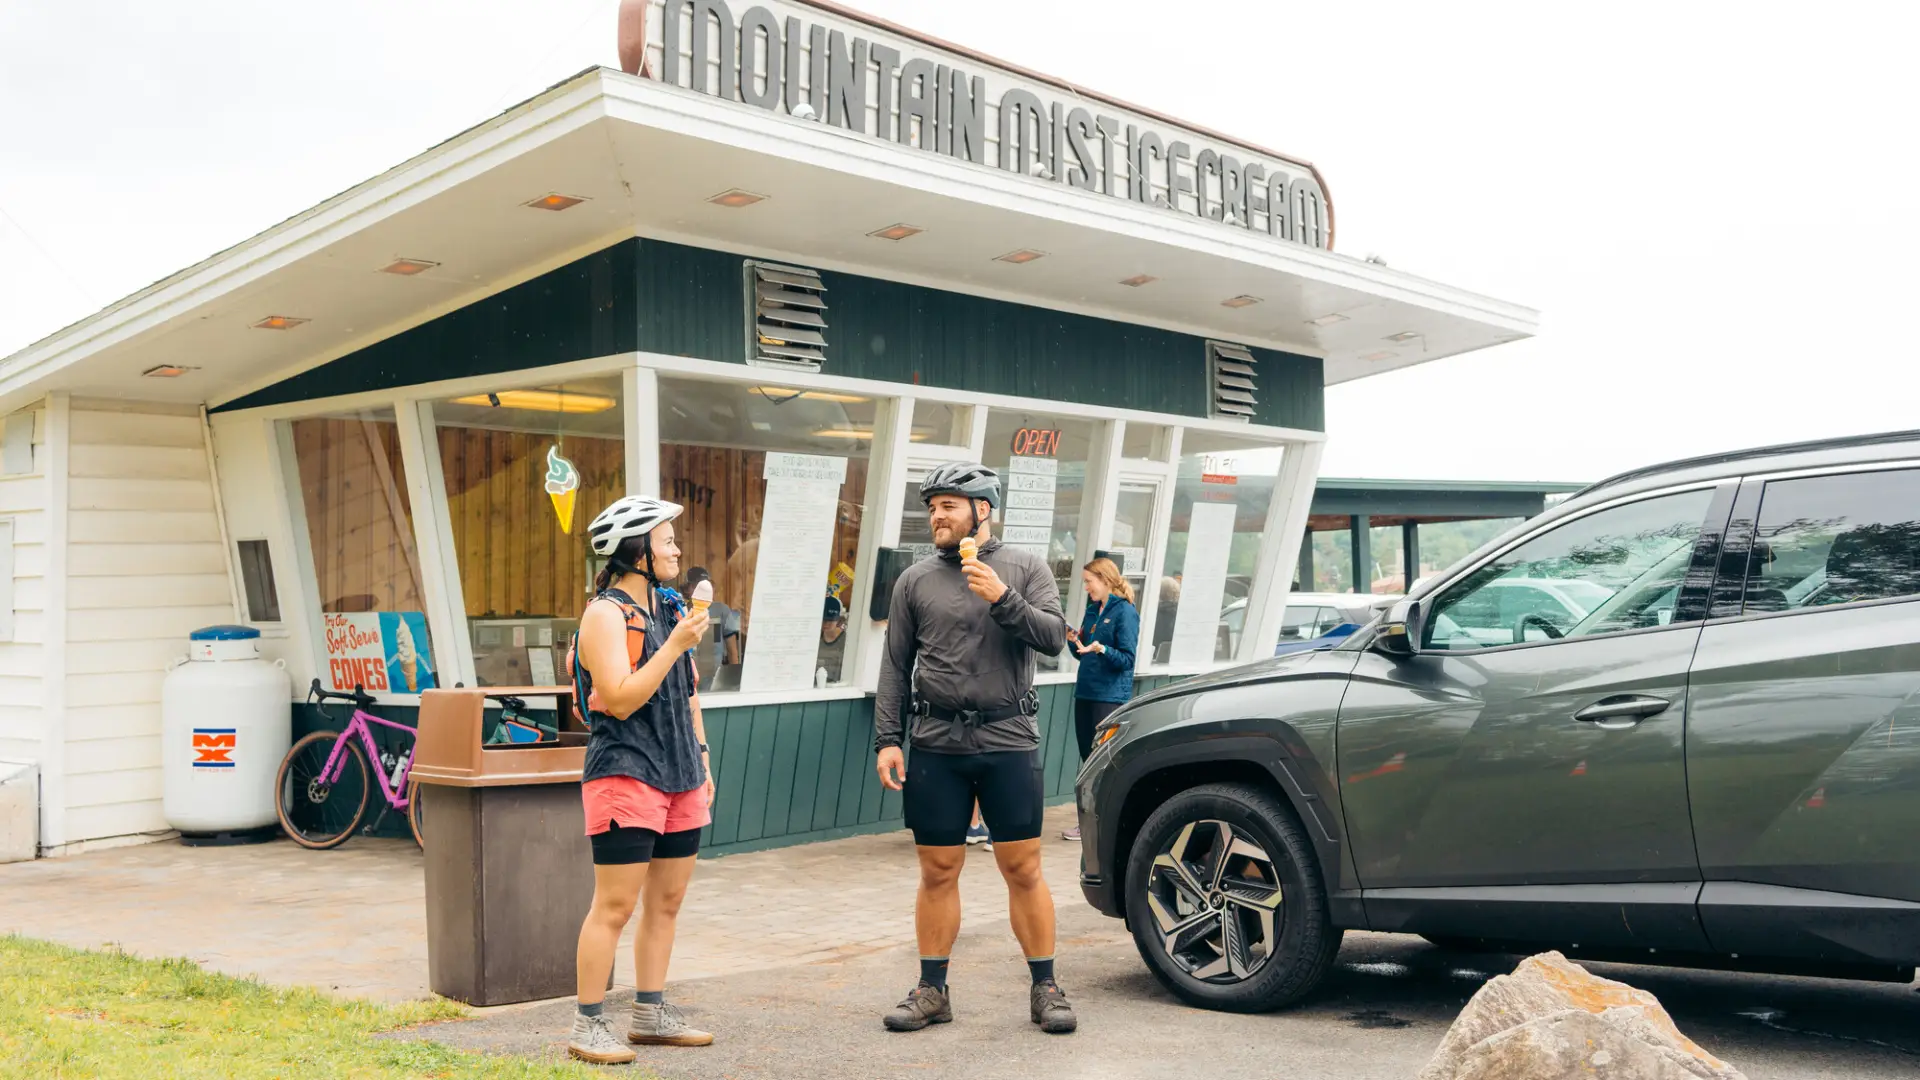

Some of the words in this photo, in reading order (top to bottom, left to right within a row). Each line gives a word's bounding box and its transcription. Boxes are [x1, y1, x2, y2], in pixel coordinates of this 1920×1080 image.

[664, 0, 985, 165] MOUNTAIN
[999, 87, 1120, 197] MIST
[1126, 124, 1192, 213] ICE
[1196, 148, 1326, 249] CREAM
[1013, 428, 1062, 456] OPEN
[324, 614, 335, 629] Try
[335, 613, 349, 628] Our
[326, 627, 349, 656] Soft
[348, 624, 380, 650] Serve
[329, 657, 388, 691] CONES
